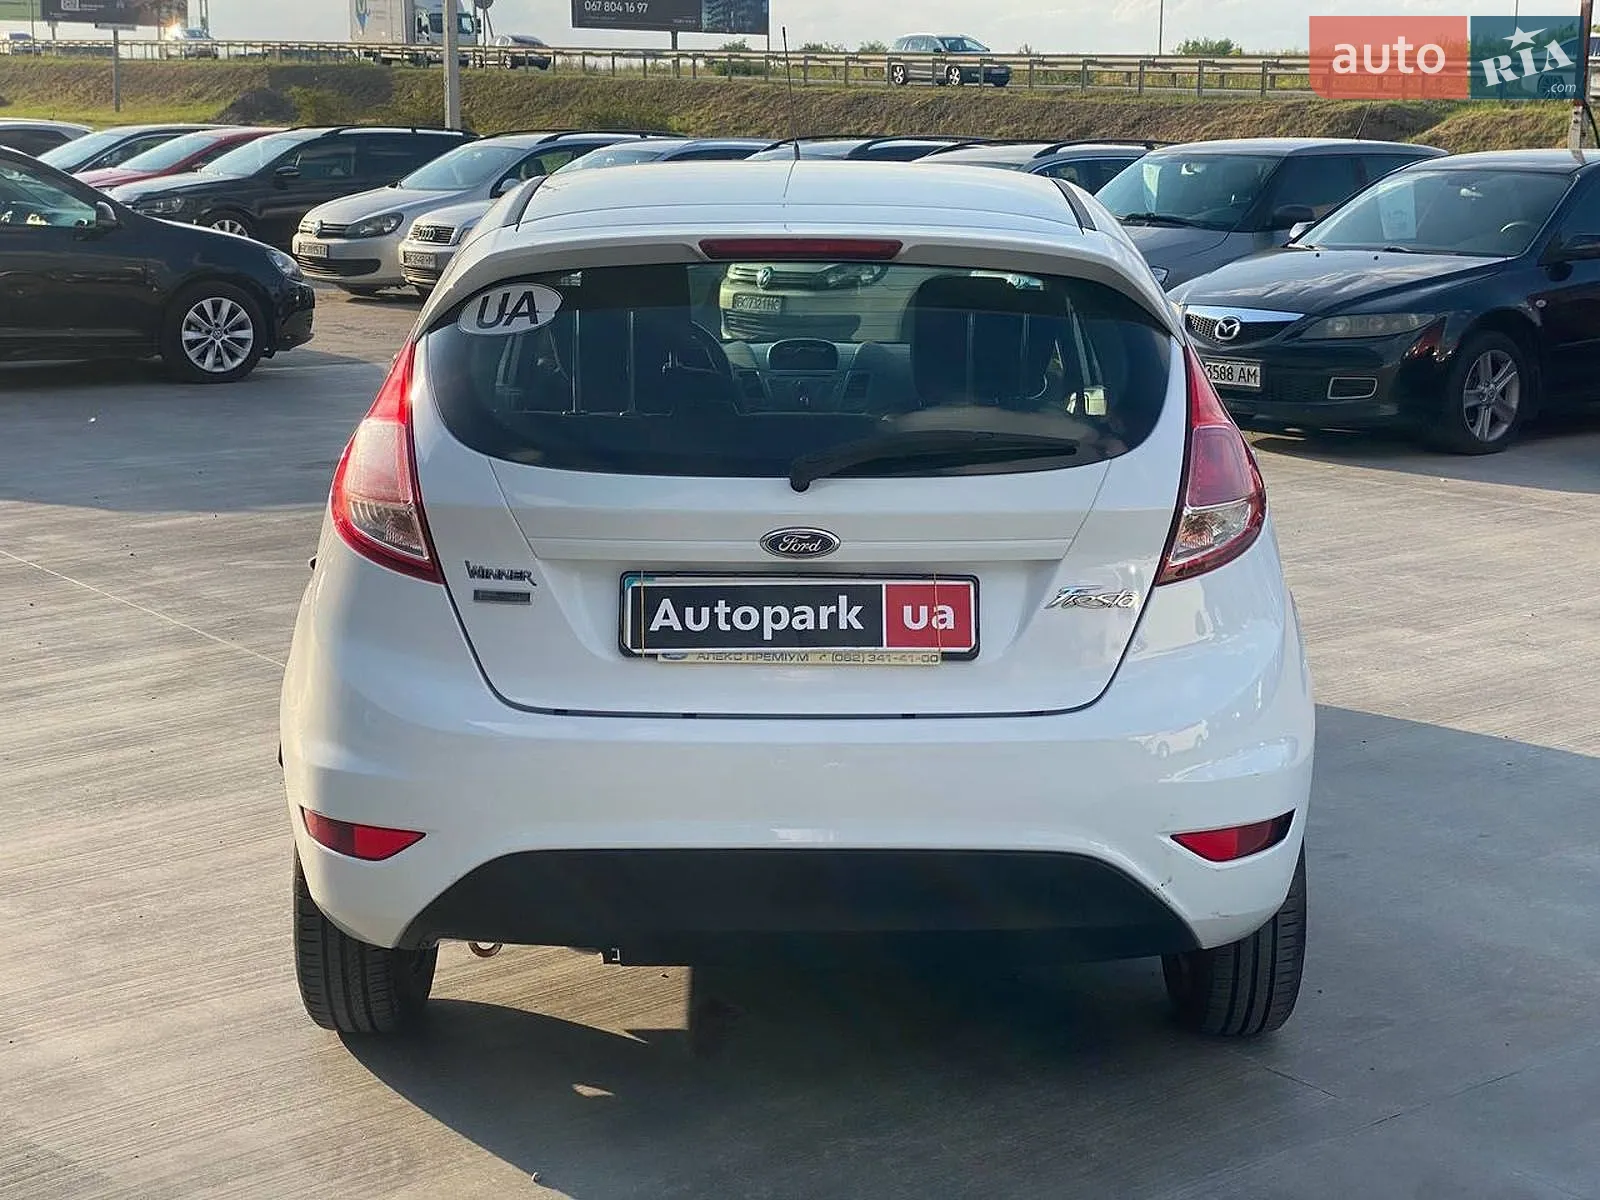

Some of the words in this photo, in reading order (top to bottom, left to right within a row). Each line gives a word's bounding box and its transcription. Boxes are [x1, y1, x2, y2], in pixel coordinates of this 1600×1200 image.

[584, 0, 601, 11] 067
[604, 1, 622, 12] 804
[625, 2, 635, 13] 16
[637, 3, 649, 13] 97
[476, 290, 539, 329] UA
[1238, 366, 1258, 384] AM
[778, 533, 822, 552] Ford
[464, 560, 537, 586] WINNER
[649, 595, 865, 641] Autopark
[903, 603, 955, 631] ua
